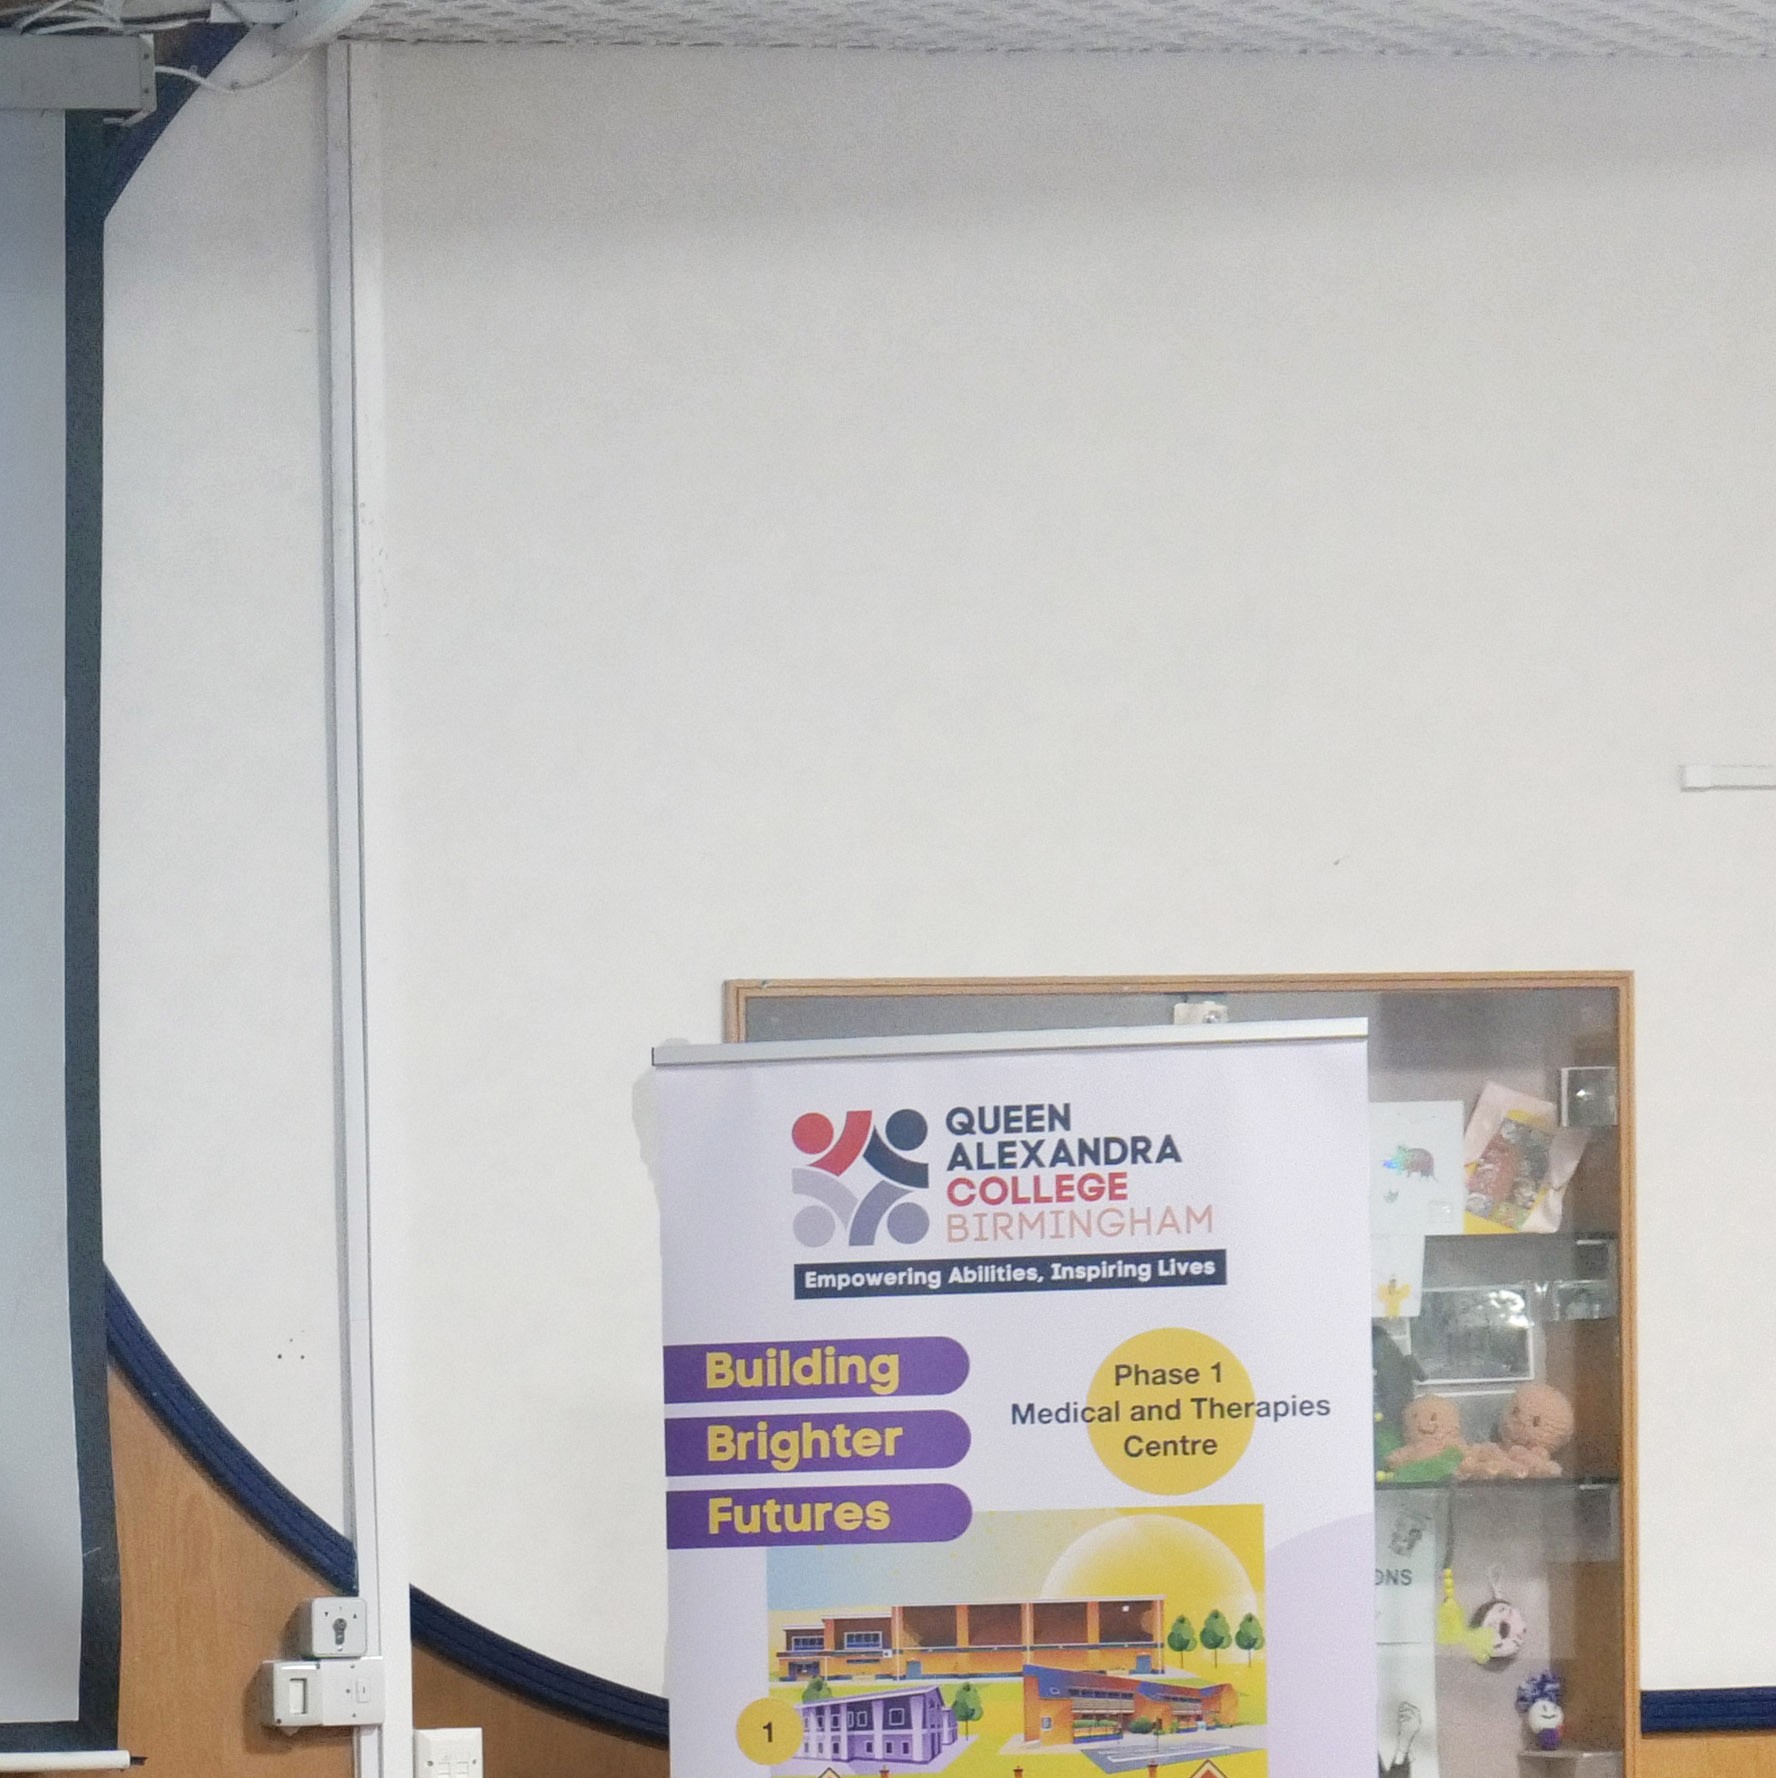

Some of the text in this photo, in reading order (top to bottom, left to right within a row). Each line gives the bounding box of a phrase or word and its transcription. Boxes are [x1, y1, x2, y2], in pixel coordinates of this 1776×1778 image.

[945, 1102, 1071, 1136] QUEEN
[946, 1134, 1183, 1172] ALEXANDRA
[946, 1171, 1128, 1207] COLLEGE
[946, 1204, 1213, 1243] BIRMINGHAM
[805, 1257, 1216, 1291] Empowering Abilities, Inspiring Lives
[706, 1346, 900, 1395] Building
[1114, 1361, 1221, 1387] Phase 1
[1011, 1395, 1331, 1425] Medical and Therapies
[707, 1421, 904, 1472] Brighter
[1123, 1434, 1218, 1458] Centre
[709, 1496, 891, 1534] Futures
[762, 1721, 773, 1743] 1
